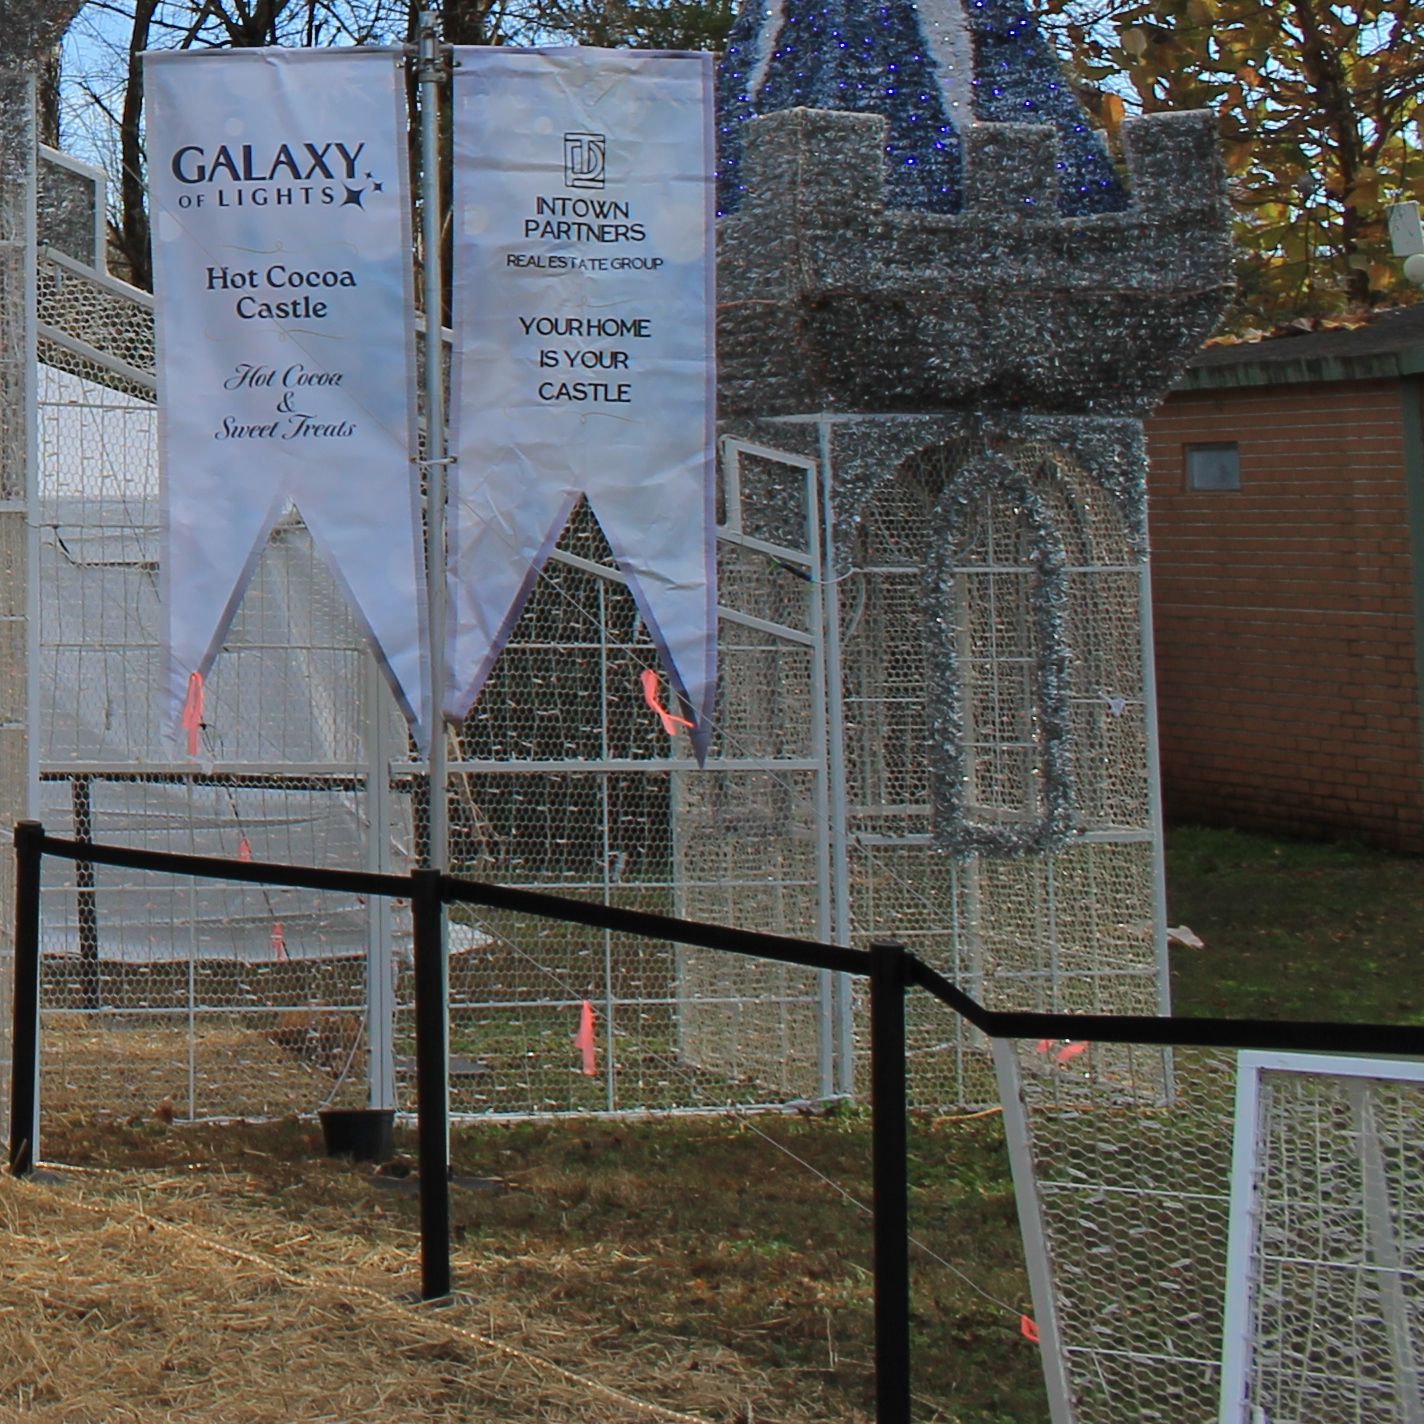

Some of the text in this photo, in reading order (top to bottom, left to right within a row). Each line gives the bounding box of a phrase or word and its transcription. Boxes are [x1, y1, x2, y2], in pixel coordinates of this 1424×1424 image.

[171, 142, 365, 184] GALAXY
[178, 186, 334, 209] OF LIGHTS
[536, 196, 629, 220] INTOWN
[525, 219, 646, 243] PARTNERS
[506, 254, 663, 271] REAL ESTATE GROUP
[206, 265, 357, 290] Hot Cocoa
[236, 296, 328, 319] Castle
[518, 316, 651, 338] YOUR HOME
[540, 350, 629, 369] IS YOUR
[223, 363, 344, 390] Hot Cocoa
[277, 391, 295, 413] &
[538, 382, 631, 403] CASTLE
[215, 413, 356, 441] Sweet Treats
